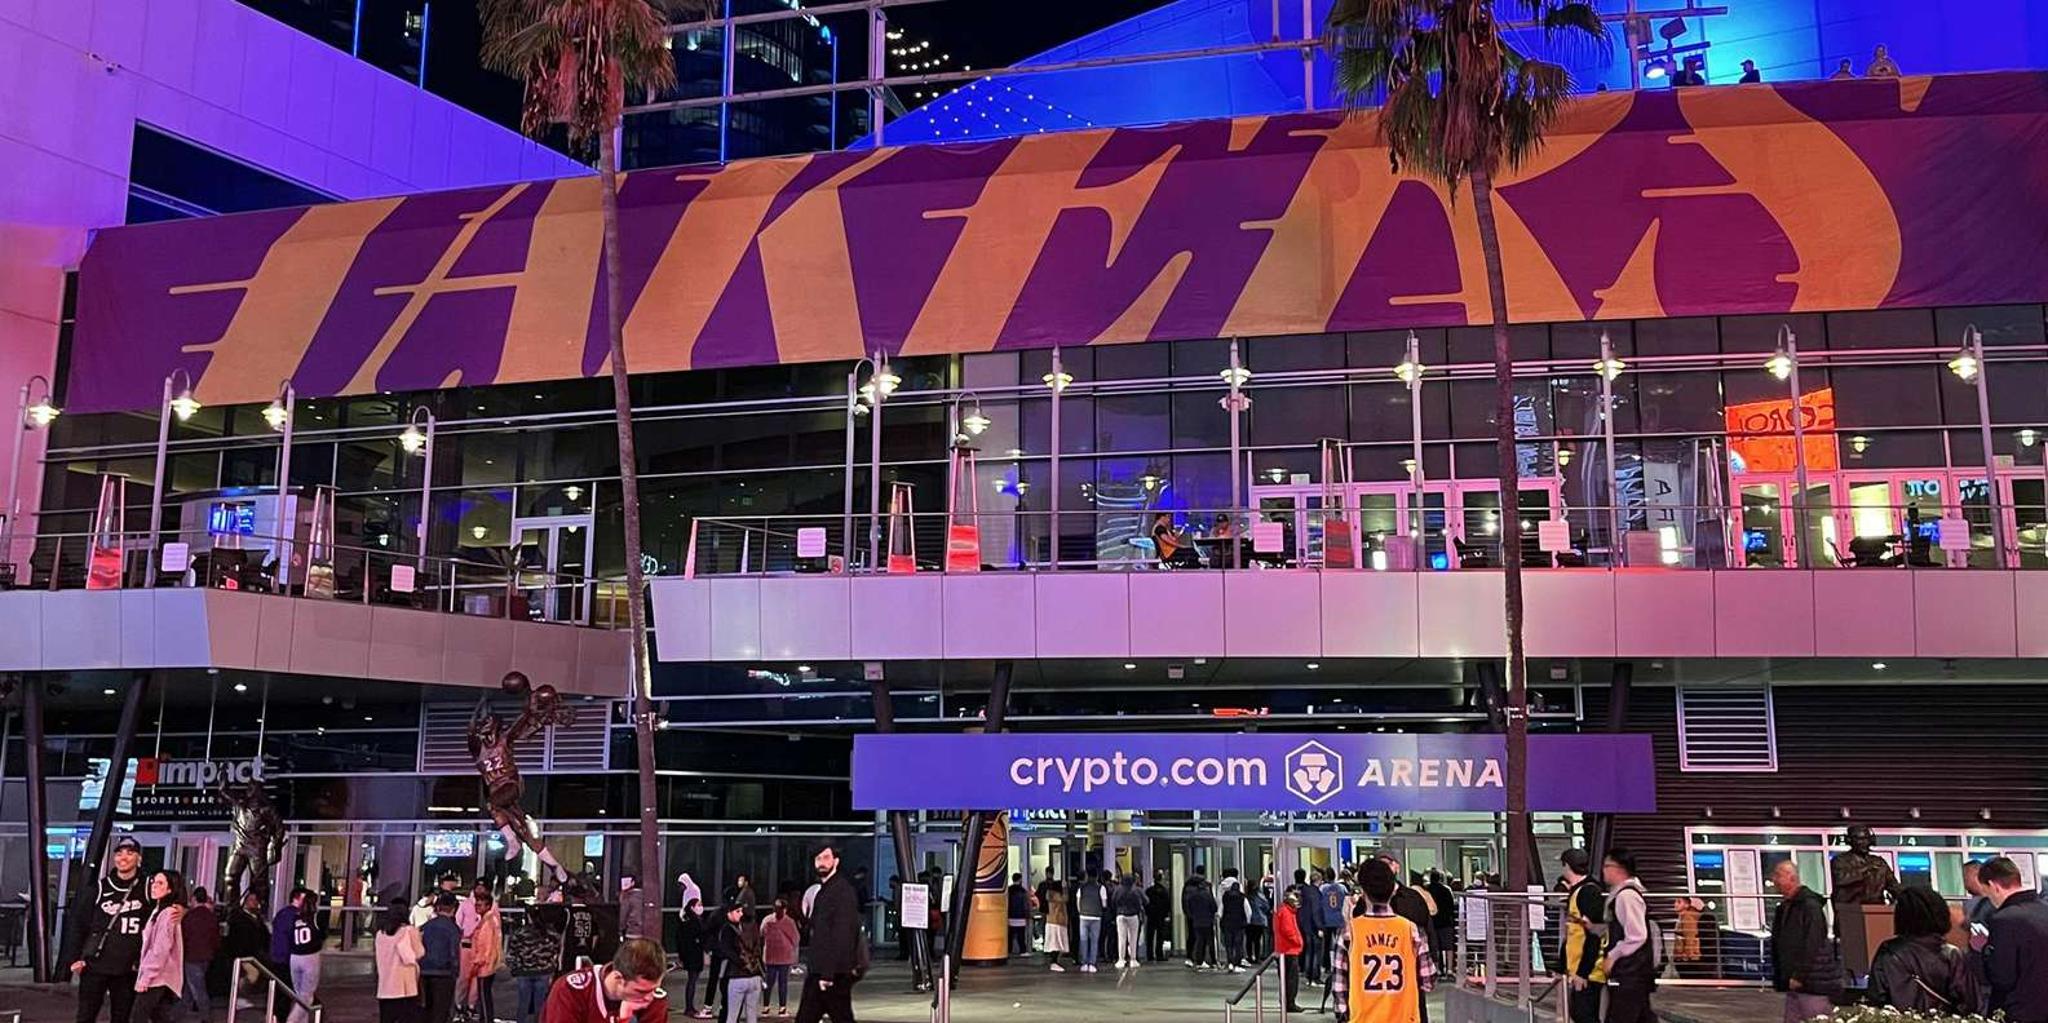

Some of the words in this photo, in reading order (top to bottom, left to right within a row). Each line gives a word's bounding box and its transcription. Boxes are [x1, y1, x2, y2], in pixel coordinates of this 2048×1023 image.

[483, 756, 504, 772] 22
[1009, 751, 1267, 793] crypto.com
[1357, 758, 1504, 788] ARENA
[135, 796, 180, 805] SPORTS
[192, 796, 215, 805] BAR
[1702, 835, 1709, 844] 1
[1770, 835, 1778, 845] 2
[1907, 836, 1916, 847] 4
[121, 917, 141, 934] 15
[294, 927, 311, 945] 10
[1365, 932, 1399, 949] JAMES
[1363, 954, 1404, 991] 23
